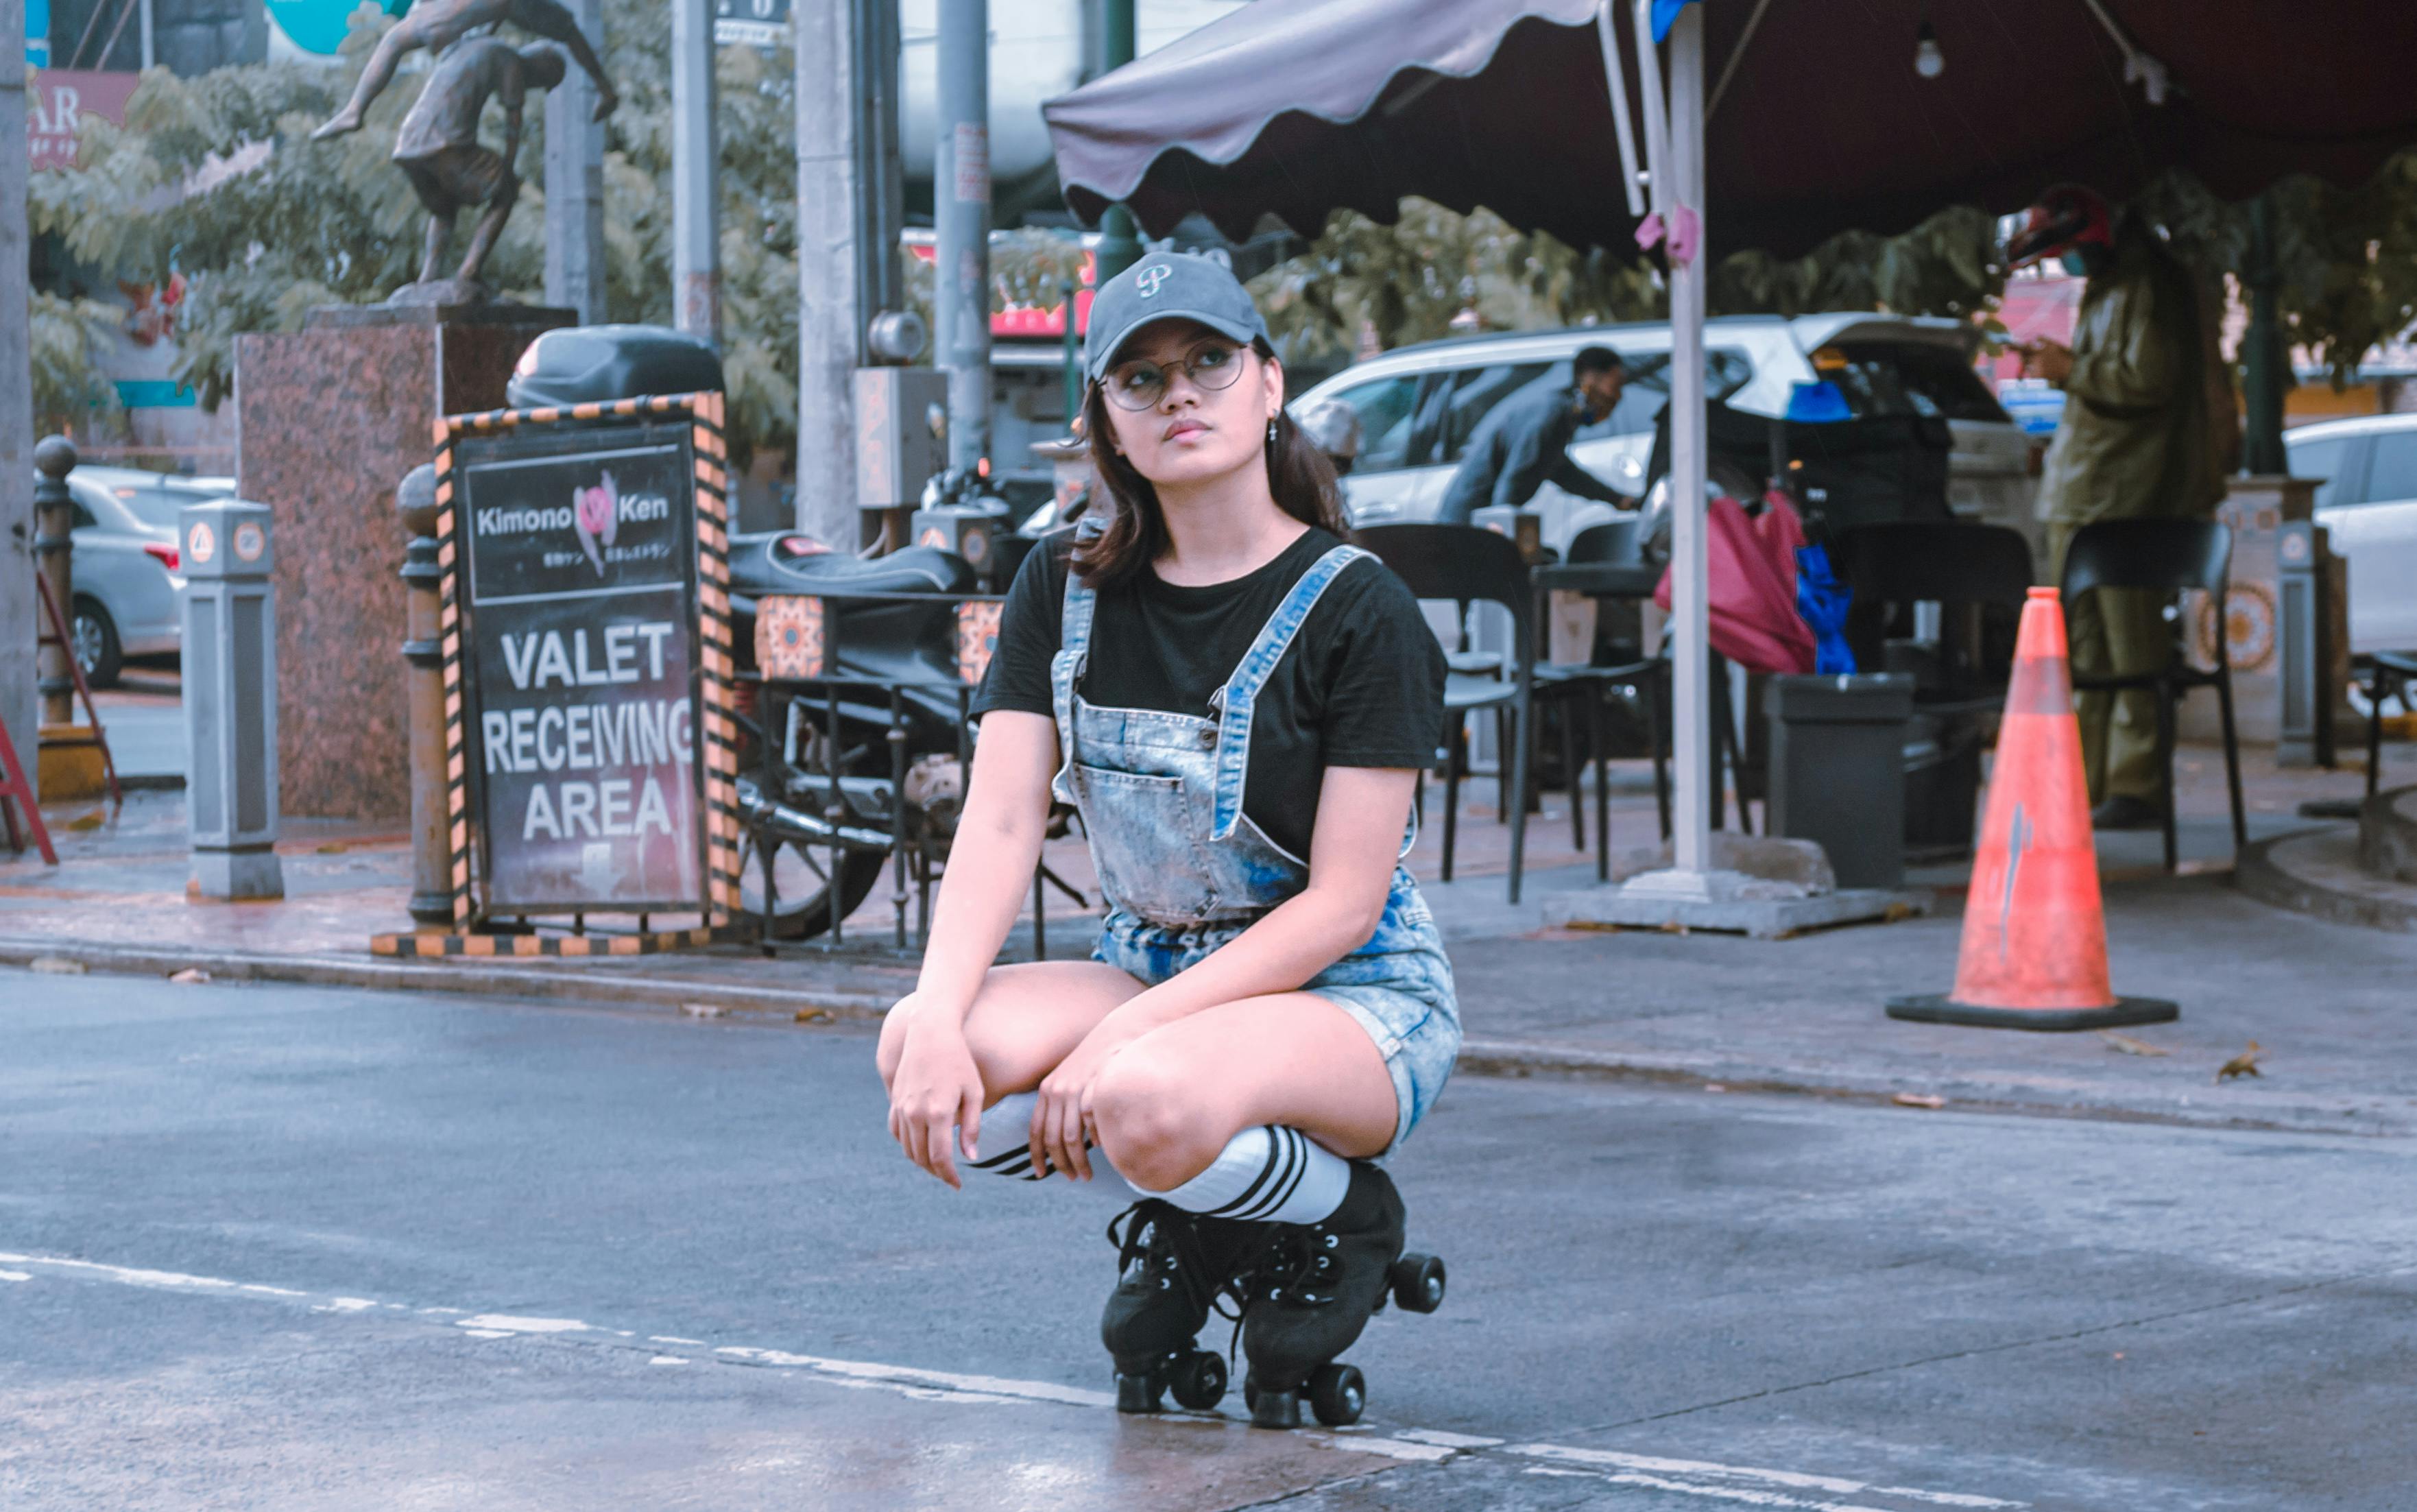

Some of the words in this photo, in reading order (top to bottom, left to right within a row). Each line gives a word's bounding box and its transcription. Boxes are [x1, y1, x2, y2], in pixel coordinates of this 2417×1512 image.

[1135, 264, 1173, 299] P
[478, 506, 572, 536] Kimono
[619, 494, 669, 522] Ken
[501, 622, 673, 688] VALET
[483, 698, 693, 773] RECEIVING
[522, 777, 672, 841] AREA
